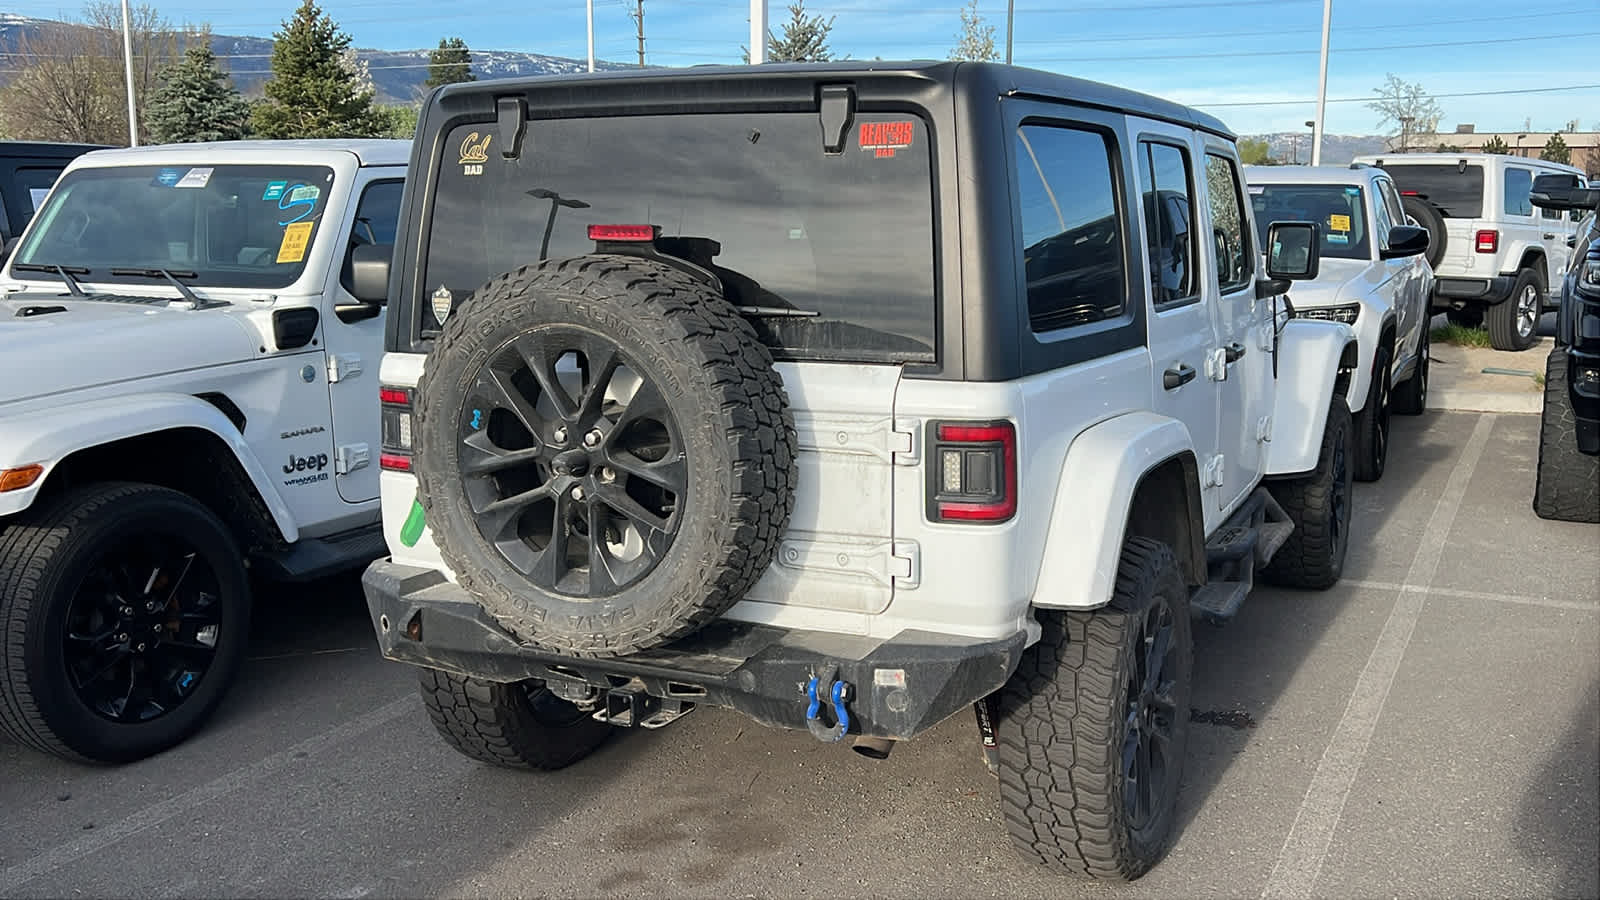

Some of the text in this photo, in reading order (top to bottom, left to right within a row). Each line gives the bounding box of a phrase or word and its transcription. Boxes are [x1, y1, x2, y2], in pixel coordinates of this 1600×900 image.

[458, 132, 492, 164] Cal
[463, 165, 483, 176] DAD
[280, 425, 325, 440] SAHARA
[282, 453, 328, 474] Jeep
[283, 473, 329, 487] WRANGLER
[478, 568, 548, 623] BOSS
